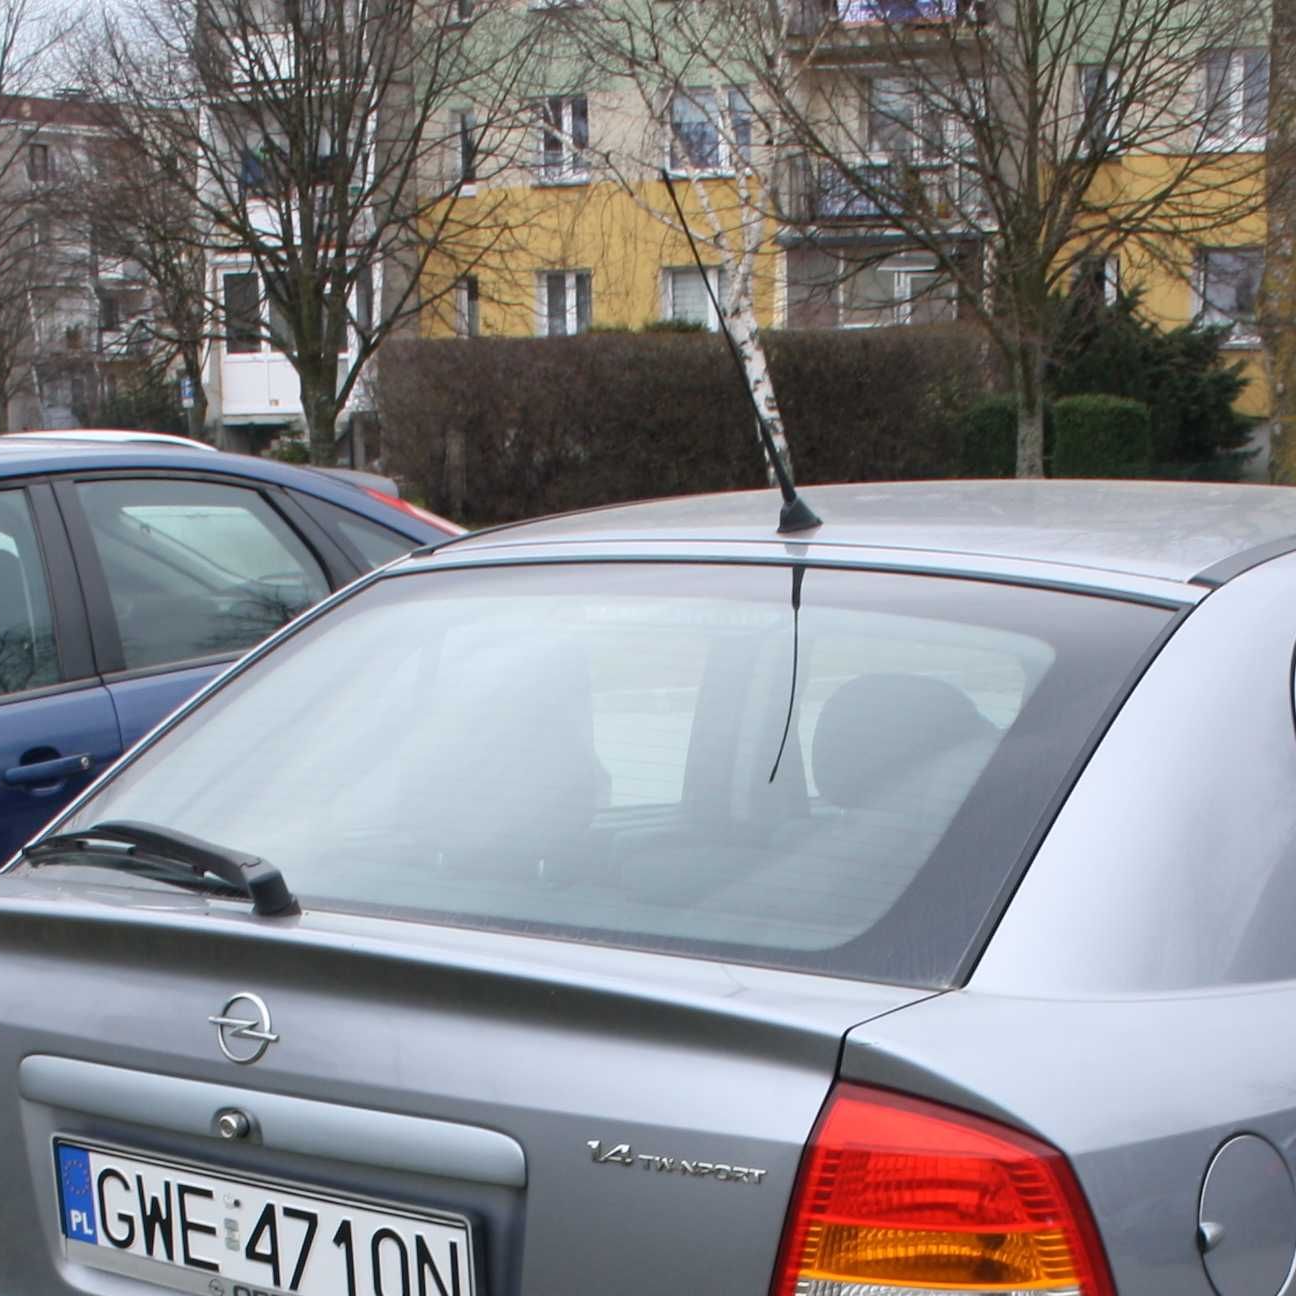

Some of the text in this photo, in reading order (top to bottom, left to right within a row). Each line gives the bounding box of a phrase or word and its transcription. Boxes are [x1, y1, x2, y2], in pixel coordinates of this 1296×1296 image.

[638, 1153, 767, 1185] TWNPORT
[70, 1209, 94, 1236] PL
[96, 1167, 220, 1273] GWE
